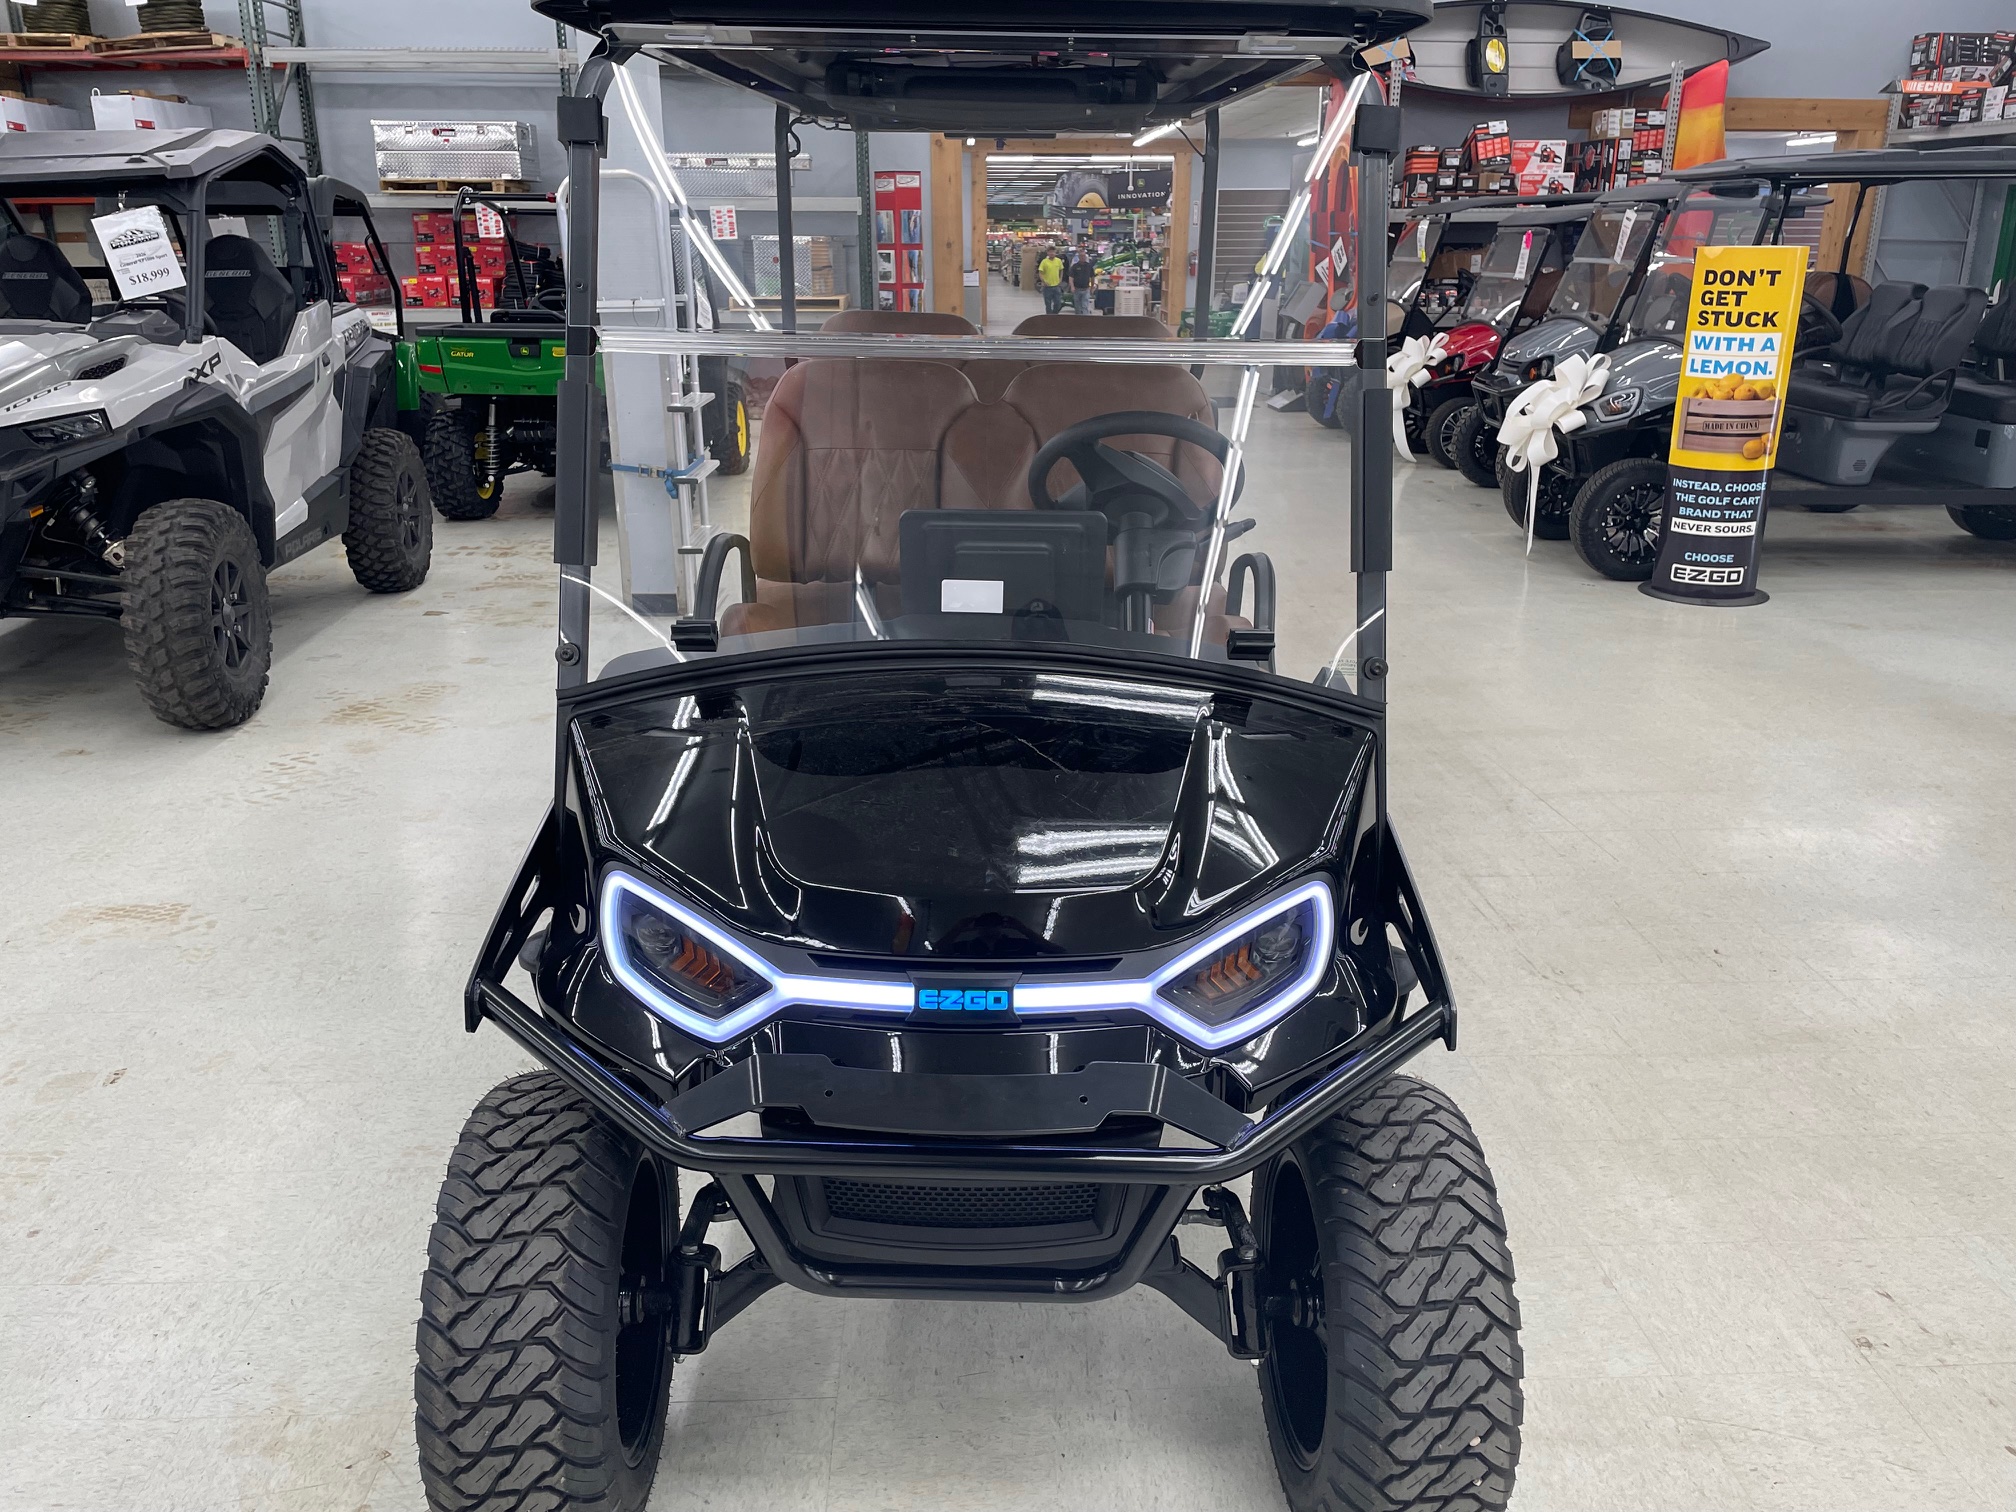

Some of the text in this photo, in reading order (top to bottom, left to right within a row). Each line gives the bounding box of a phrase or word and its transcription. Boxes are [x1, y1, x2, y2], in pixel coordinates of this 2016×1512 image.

[1915, 82, 1953, 92] ECHO
[1117, 191, 1167, 200] INNOVATION
[128, 267, 170, 286] $18,999
[1703, 269, 1782, 287] DON'T
[1700, 290, 1748, 307] GET
[1697, 310, 1779, 328] STUCK
[1693, 335, 1775, 352] WITH A
[450, 350, 474, 358] GATOR
[188, 352, 222, 380] XP
[1689, 358, 1773, 376] LEMON.
[4, 381, 72, 412] 1000
[1704, 421, 1758, 430] MADE IN CHINA
[1672, 478, 1767, 493] INSTEAD, CHOOSE
[1675, 492, 1761, 506] THE GOLF CART
[1678, 507, 1754, 519] BRAND THAT
[1673, 520, 1753, 534] NEVER SOURS.
[1684, 551, 1735, 563] CHOOSE
[1672, 567, 1743, 583] EZGO
[919, 989, 1009, 1011] EZGO
